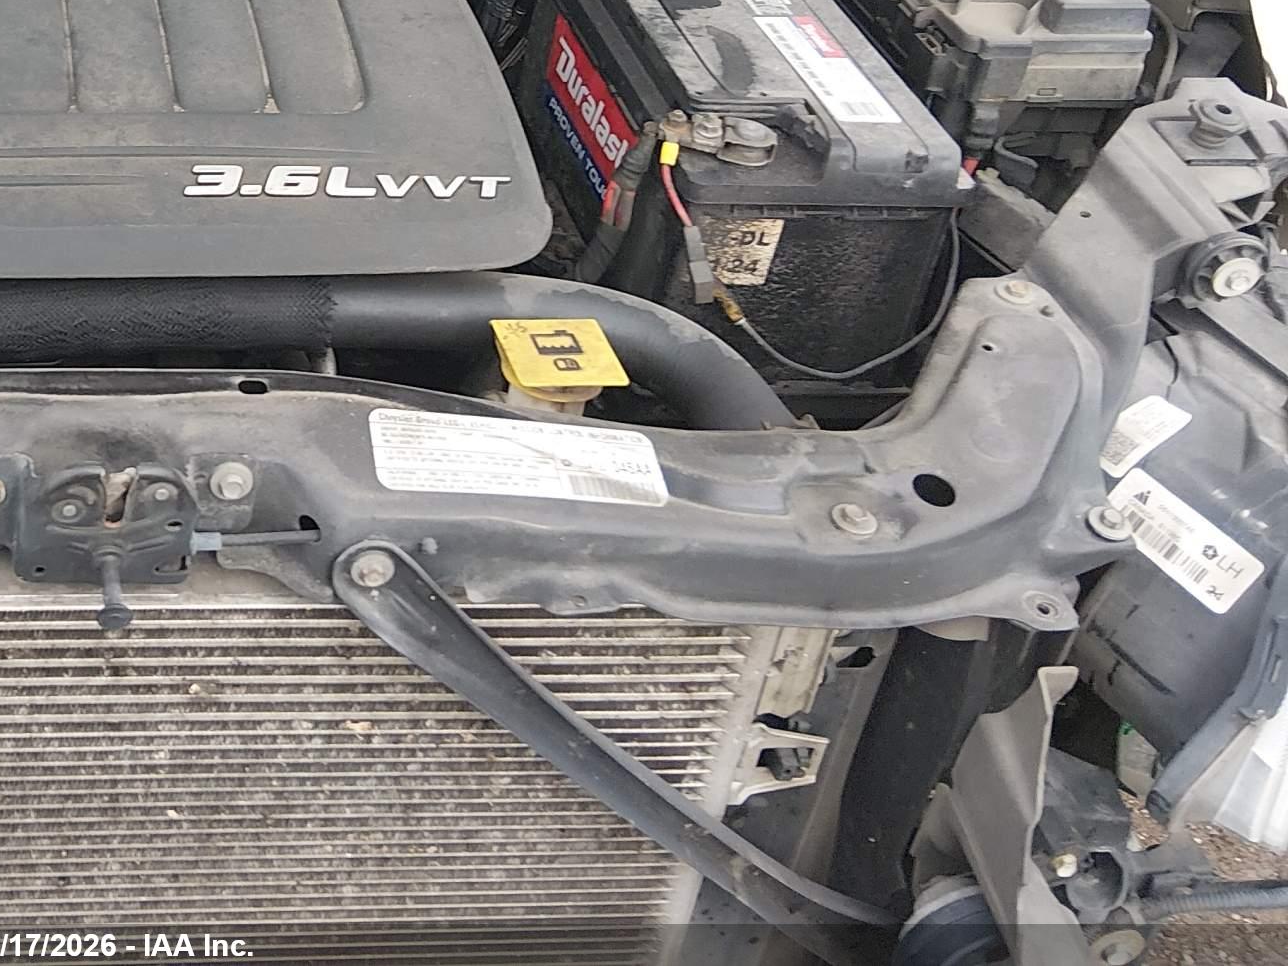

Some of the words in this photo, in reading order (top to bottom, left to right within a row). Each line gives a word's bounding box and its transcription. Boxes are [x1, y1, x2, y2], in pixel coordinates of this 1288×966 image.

[546, 96, 586, 161] PROVEN
[584, 156, 609, 201] TOU
[1215, 554, 1245, 579] LH
